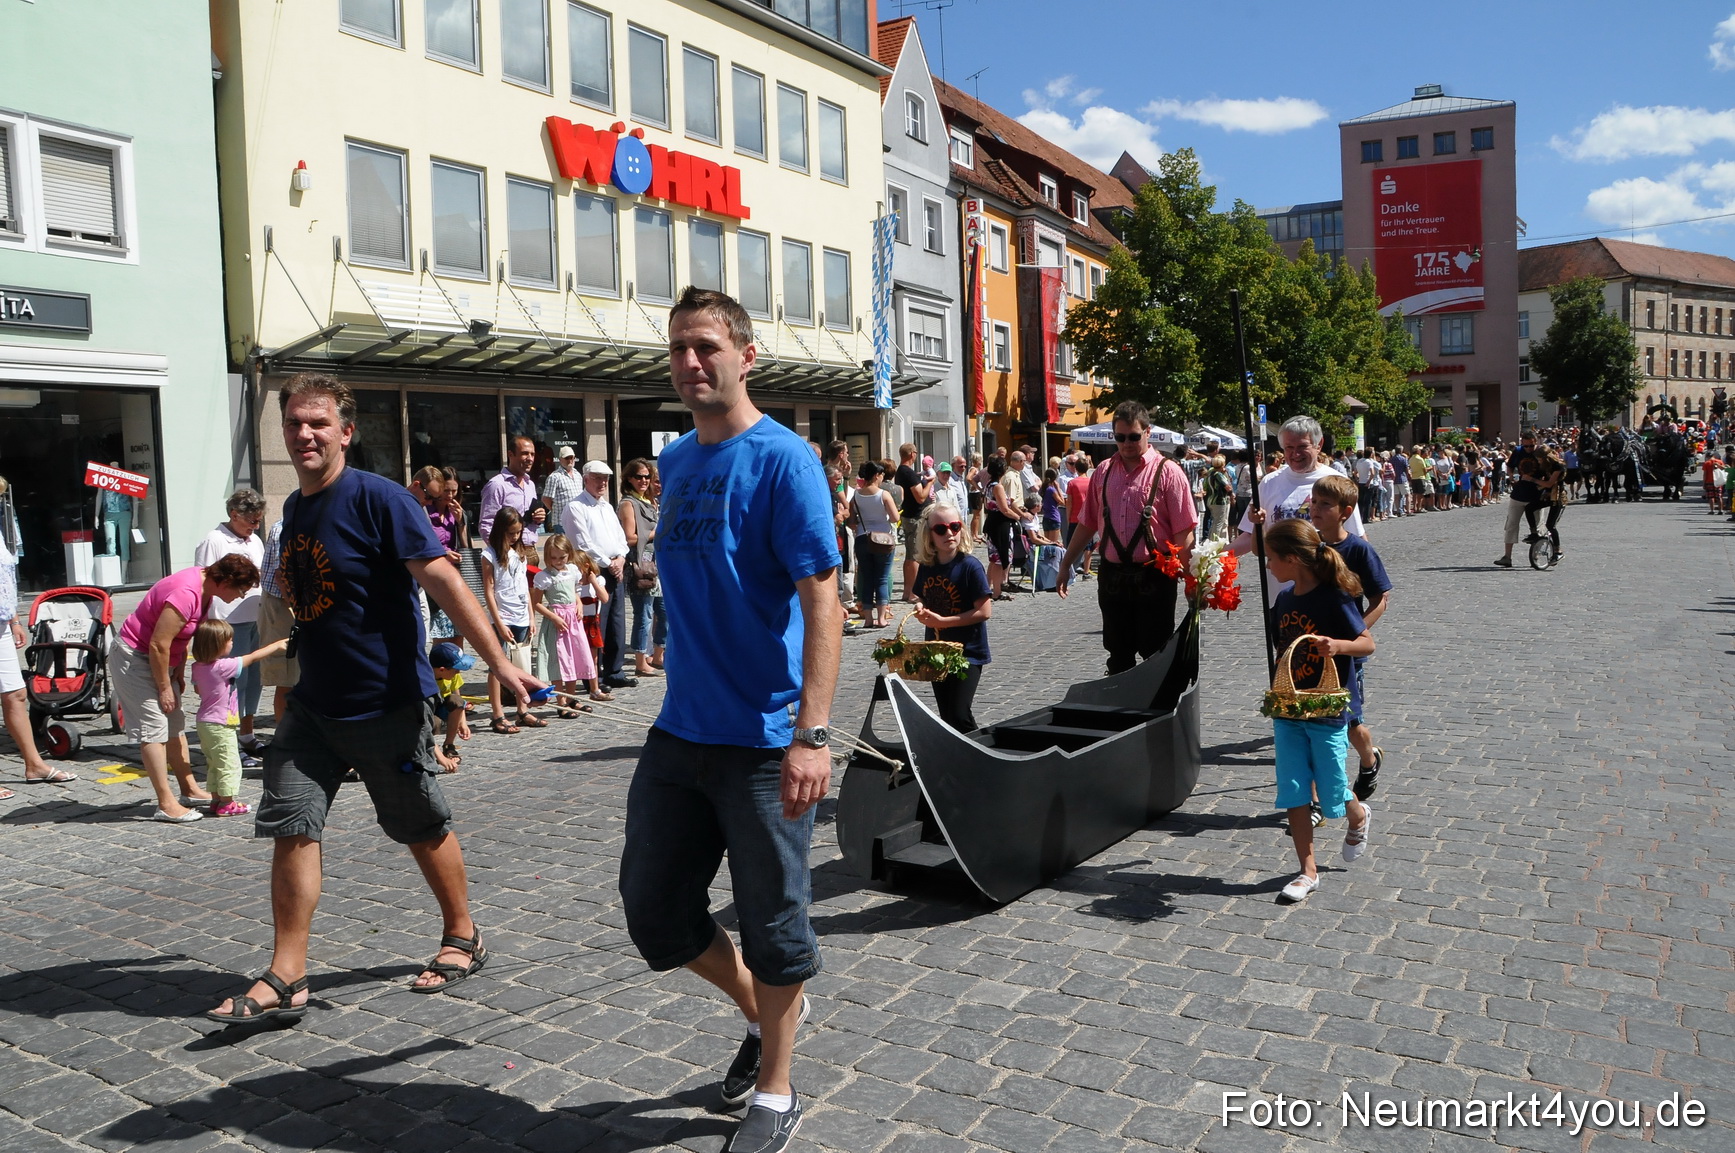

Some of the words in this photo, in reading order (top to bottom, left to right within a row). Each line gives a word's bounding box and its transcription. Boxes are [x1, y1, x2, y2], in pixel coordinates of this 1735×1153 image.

[546, 116, 750, 219] WÖHRL
[1381, 201, 1419, 214] Danke
[1381, 219, 1392, 227] für
[1394, 218, 1404, 226] Ihr
[1406, 216, 1445, 225] Vertrauen
[1382, 229, 1396, 237] und
[1399, 228, 1413, 236] Ihre
[1413, 252, 1449, 268] 175
[1415, 265, 1450, 277] JAHRE
[92, 473, 121, 491] 10%
[60, 632, 87, 640] Jeep
